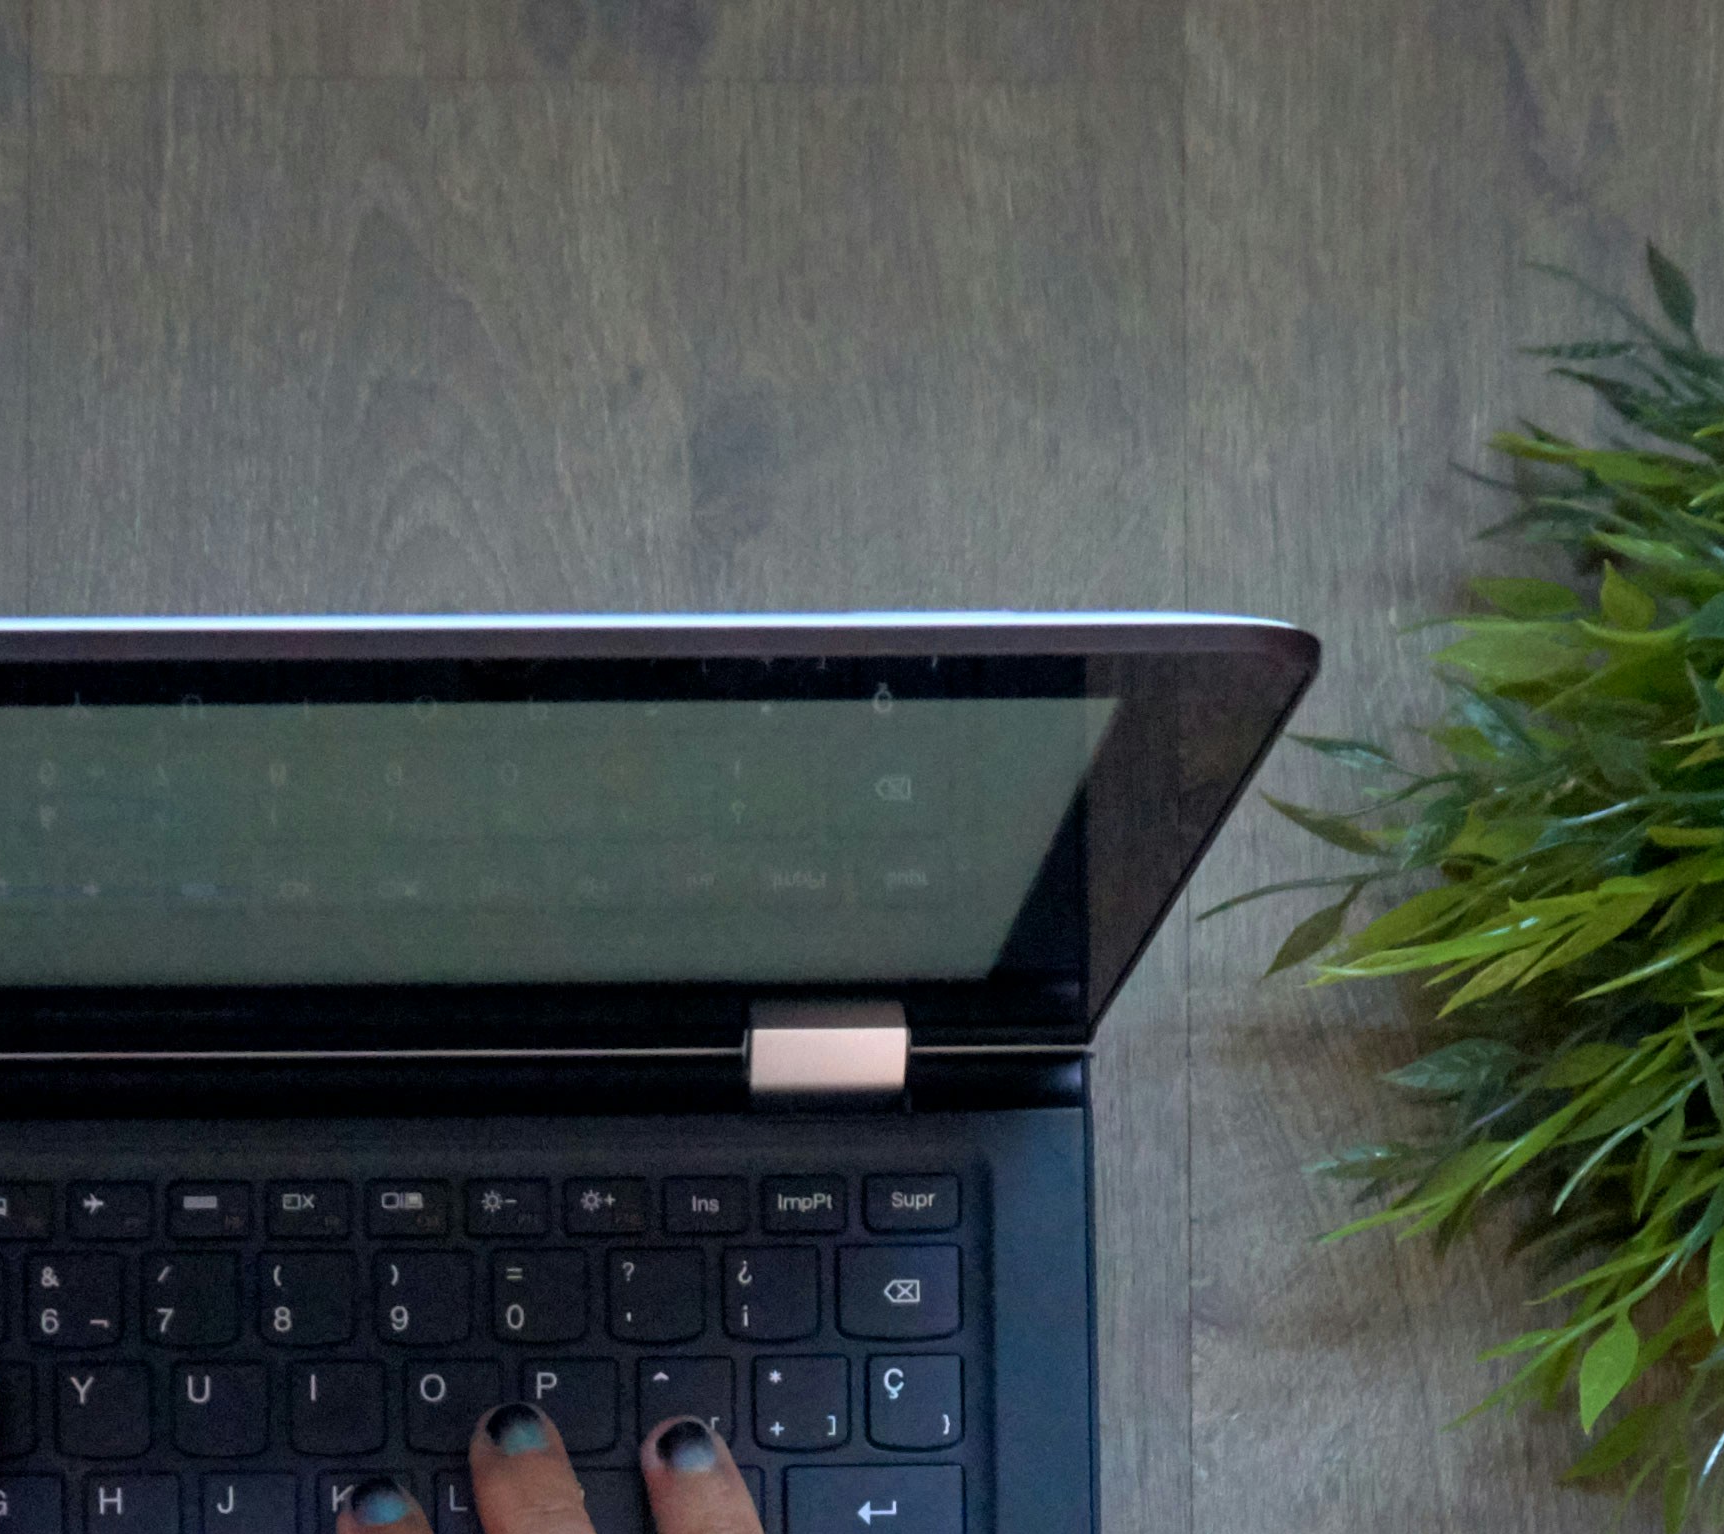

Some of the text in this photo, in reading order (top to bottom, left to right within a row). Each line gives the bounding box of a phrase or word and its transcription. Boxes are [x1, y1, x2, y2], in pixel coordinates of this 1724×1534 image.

[691, 1195, 720, 1214] Ins
[777, 1192, 833, 1213] ImpPt
[891, 1191, 936, 1211] Supr
[40, 1266, 60, 1288] &
[272, 1265, 282, 1287] (
[390, 1264, 400, 1286] )
[506, 1266, 523, 1281] =
[621, 1261, 636, 1282] ?
[40, 1307, 60, 1335] 6
[156, 1307, 175, 1333] 7
[273, 1305, 292, 1333] 8
[390, 1305, 410, 1332] 9
[505, 1303, 525, 1331] 0
[69, 1375, 95, 1405] Y
[186, 1375, 211, 1404] U
[419, 1373, 447, 1403] O
[535, 1371, 558, 1400] P
[883, 1367, 905, 1400] Ç
[98, 1487, 123, 1515] H
[216, 1485, 235, 1515] J
[448, 1484, 468, 1512] L
